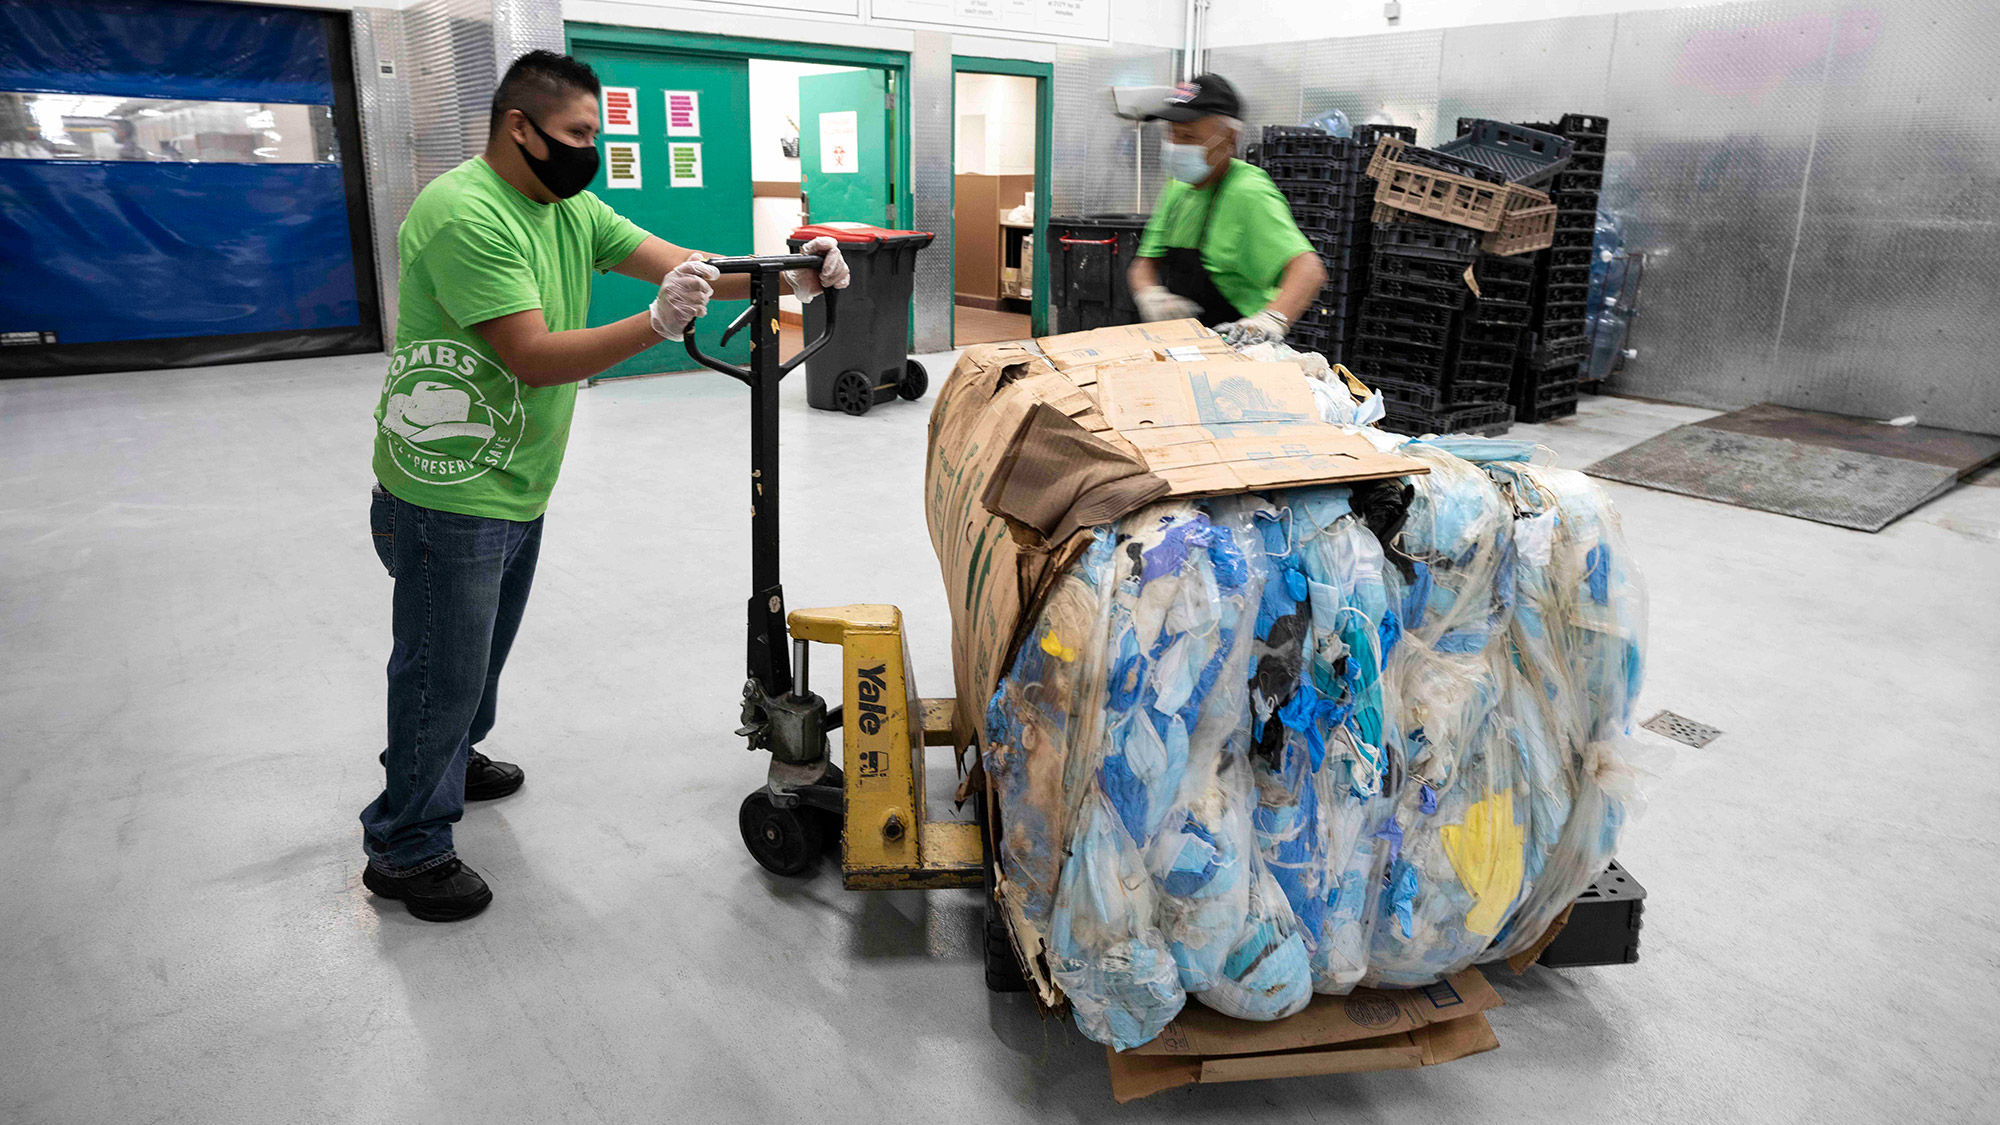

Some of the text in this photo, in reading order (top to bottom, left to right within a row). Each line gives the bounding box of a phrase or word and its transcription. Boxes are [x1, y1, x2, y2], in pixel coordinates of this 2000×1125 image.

[413, 455, 475, 475] PRESERV
[485, 436, 511, 466] SAVE
[858, 663, 887, 736] Yale
